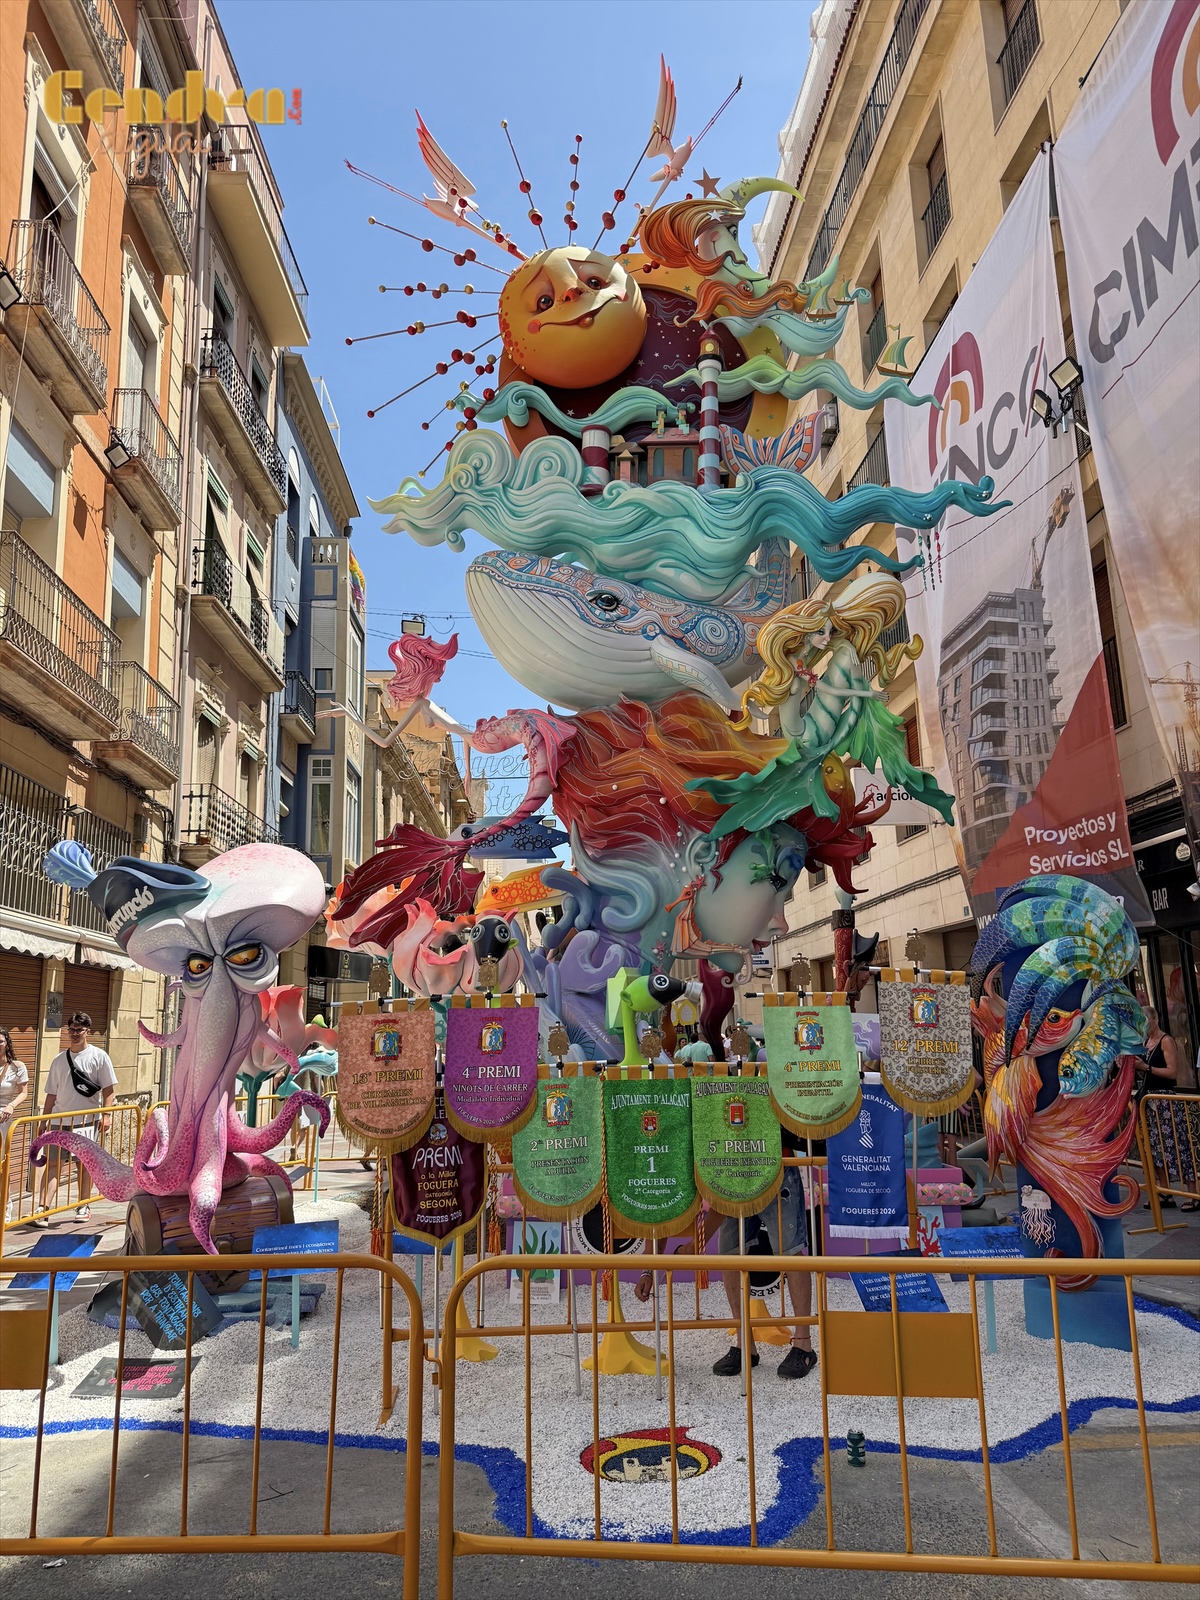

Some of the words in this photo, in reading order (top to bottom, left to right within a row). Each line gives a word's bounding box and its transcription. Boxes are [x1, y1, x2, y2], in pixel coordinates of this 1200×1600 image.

[1024, 817, 1106, 846] Proyectos
[1106, 811, 1118, 833] y
[1029, 847, 1108, 875] Servicios
[1107, 838, 1130, 865] SL
[1152, 887, 1169, 911] BAR
[915, 1039, 959, 1054] PREMI
[478, 1065, 521, 1078] PREMI
[798, 1060, 842, 1073] PREMI
[375, 1068, 424, 1083] PREMI
[452, 1084, 482, 1092] NINOTS
[483, 1084, 495, 1092] DE
[496, 1083, 528, 1092] CARRER
[489, 1094, 523, 1102] Individual
[611, 1094, 652, 1110] AJUNTAMENT
[861, 1093, 900, 1113] NERALITAT
[545, 1136, 588, 1151] PREMI
[633, 1145, 669, 1154] PREMI
[724, 1140, 767, 1153] PREMI
[412, 1144, 464, 1169] PREMI
[841, 1155, 892, 1163] GENERALITAT
[646, 1156, 657, 1173] 1
[842, 1163, 891, 1172] VALENCIANA
[417, 1179, 459, 1191] FOGUERA
[628, 1178, 676, 1187] FOGUERES
[419, 1198, 458, 1210] SEGONA
[621, 1192, 647, 1210] FOGUERES
[660, 1191, 685, 1209] ALACANT
[841, 1206, 879, 1215] FOGUERES
[879, 1206, 896, 1215] 2026
[416, 1214, 449, 1223] FOGUERES
[865, 1284, 891, 1293] homenatg
